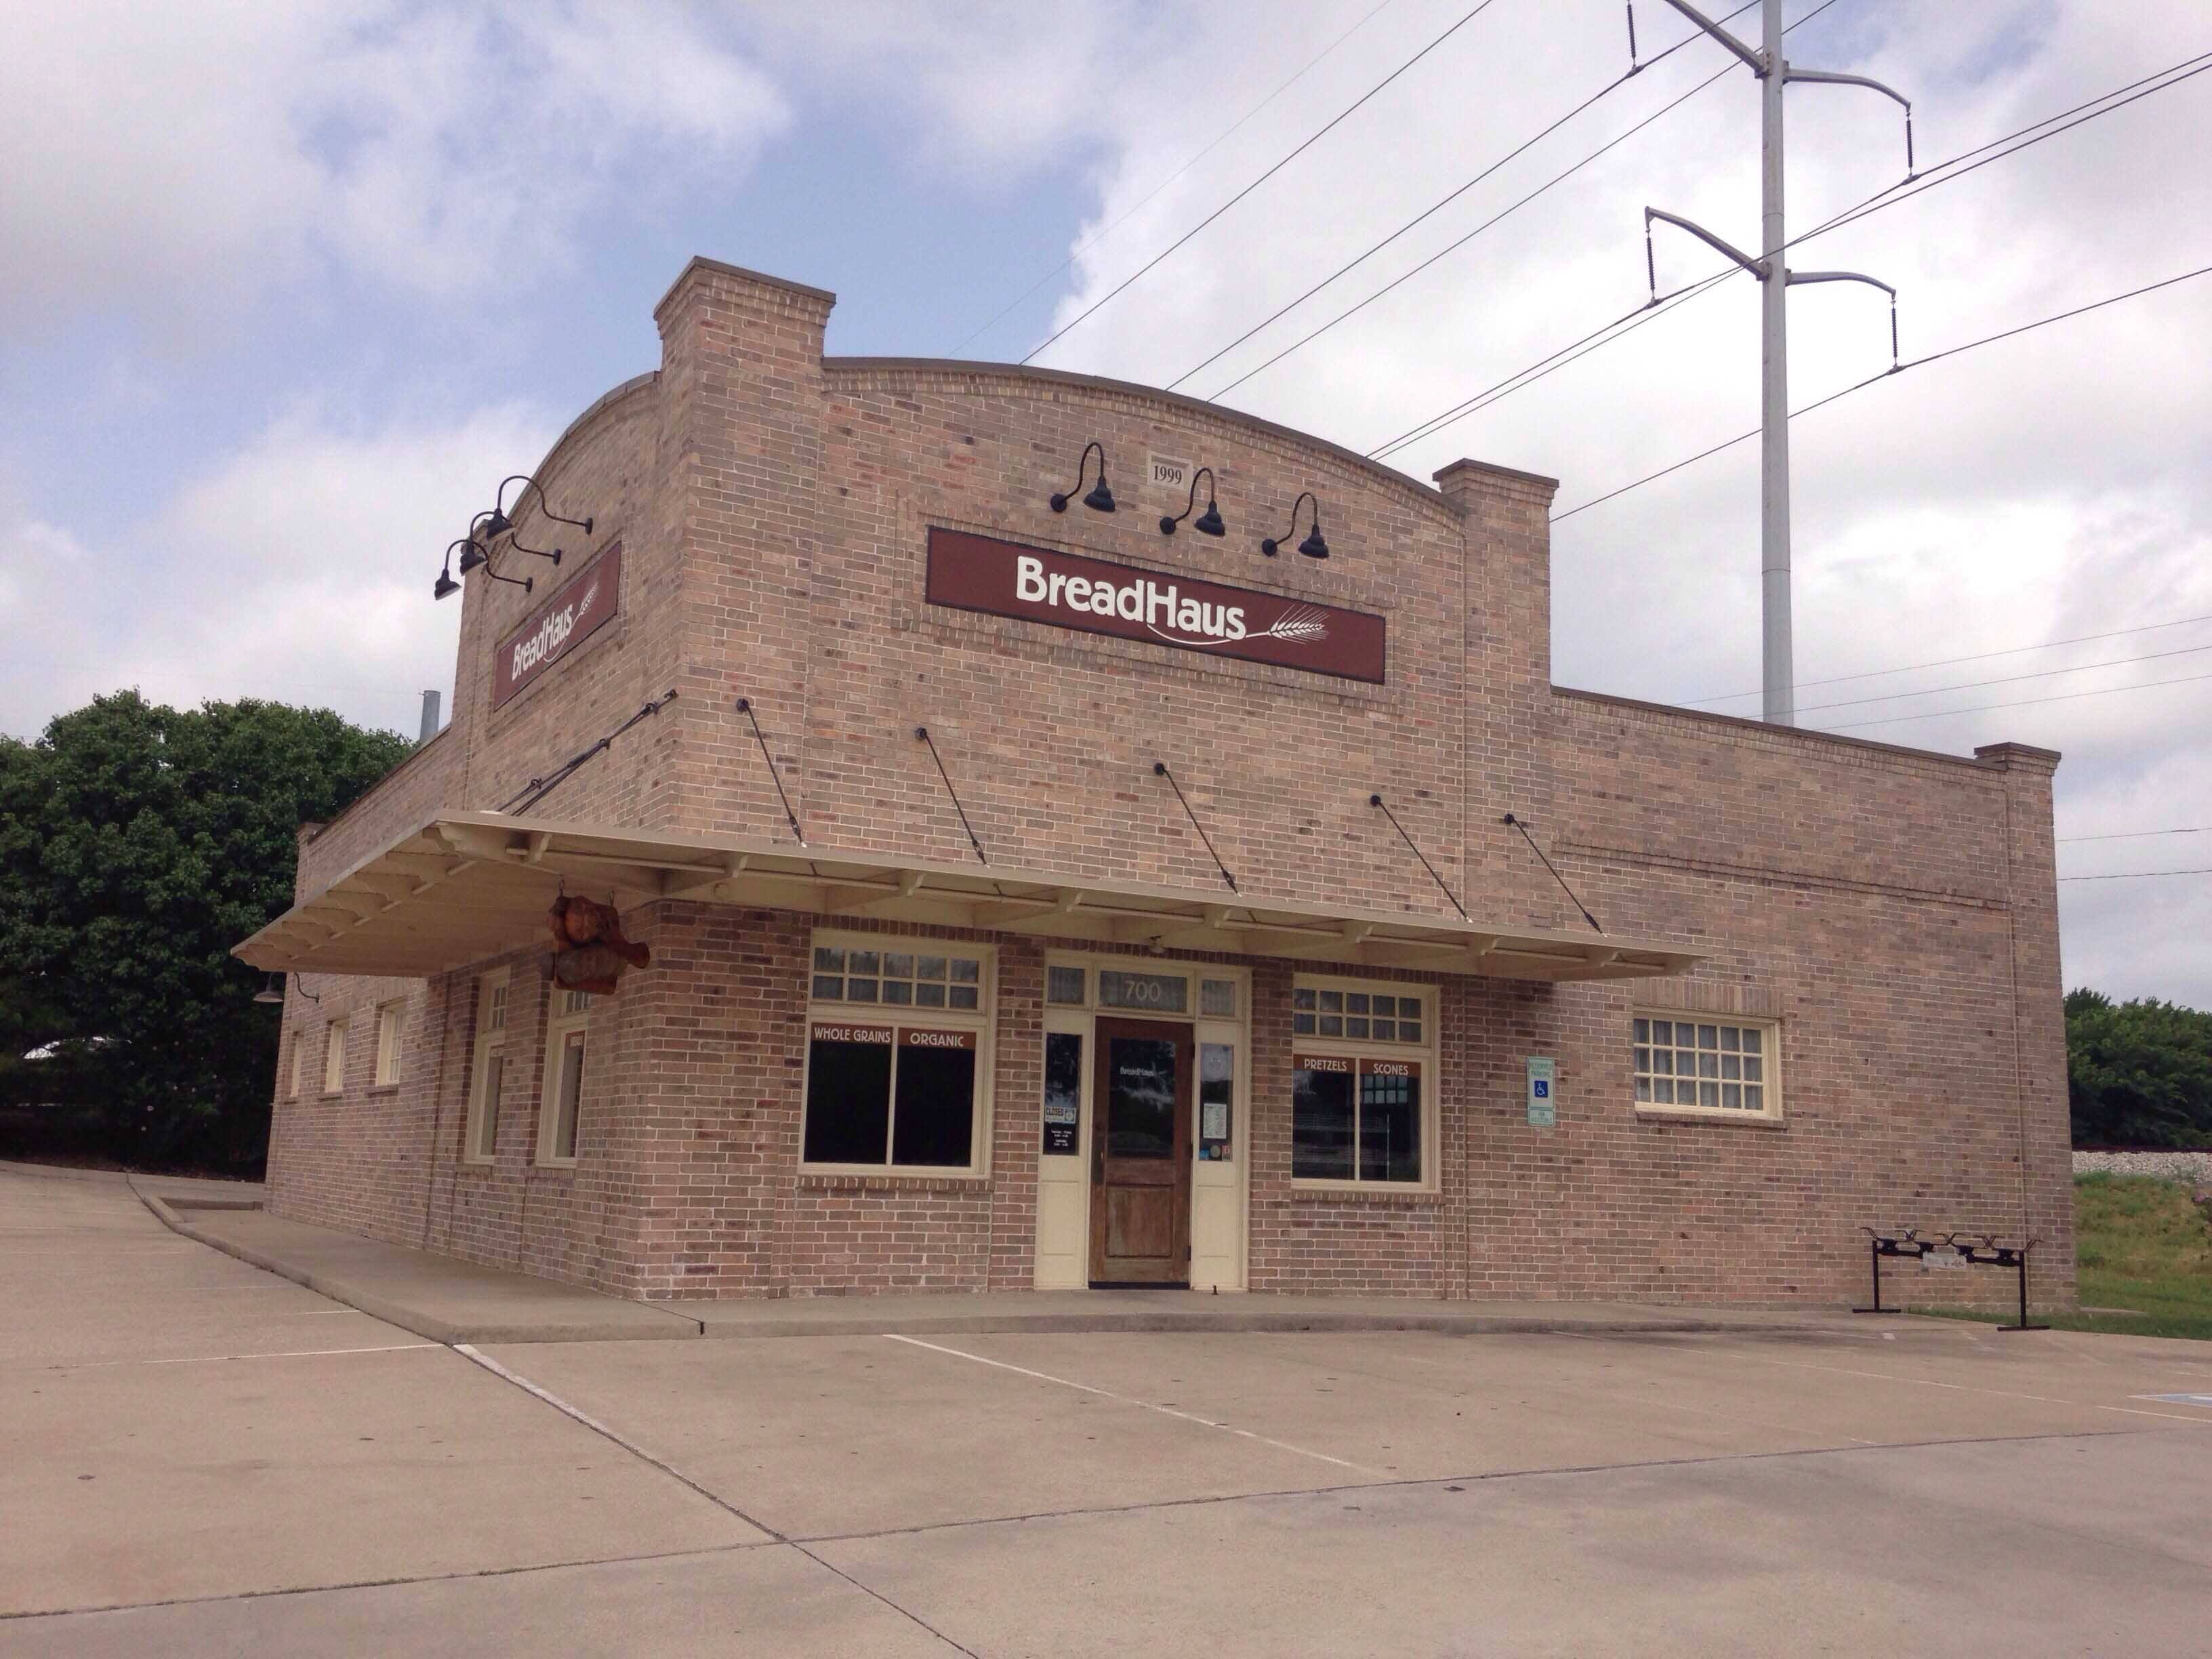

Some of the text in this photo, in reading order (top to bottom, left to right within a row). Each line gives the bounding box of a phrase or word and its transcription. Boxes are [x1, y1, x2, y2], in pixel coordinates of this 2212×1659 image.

[1154, 466, 1182, 485] 1999
[1017, 556, 1246, 640] BreadHaus
[512, 604, 573, 680] BreadHaus
[1125, 980, 1161, 1002] 700
[814, 1027, 891, 1044] WHOLE GRAINS
[909, 1032, 964, 1047] ORGANIC
[1304, 1059, 1347, 1071] PRETZELS
[1373, 1063, 1409, 1076] SCONES
[1046, 1107, 1064, 1117] CLOSED
